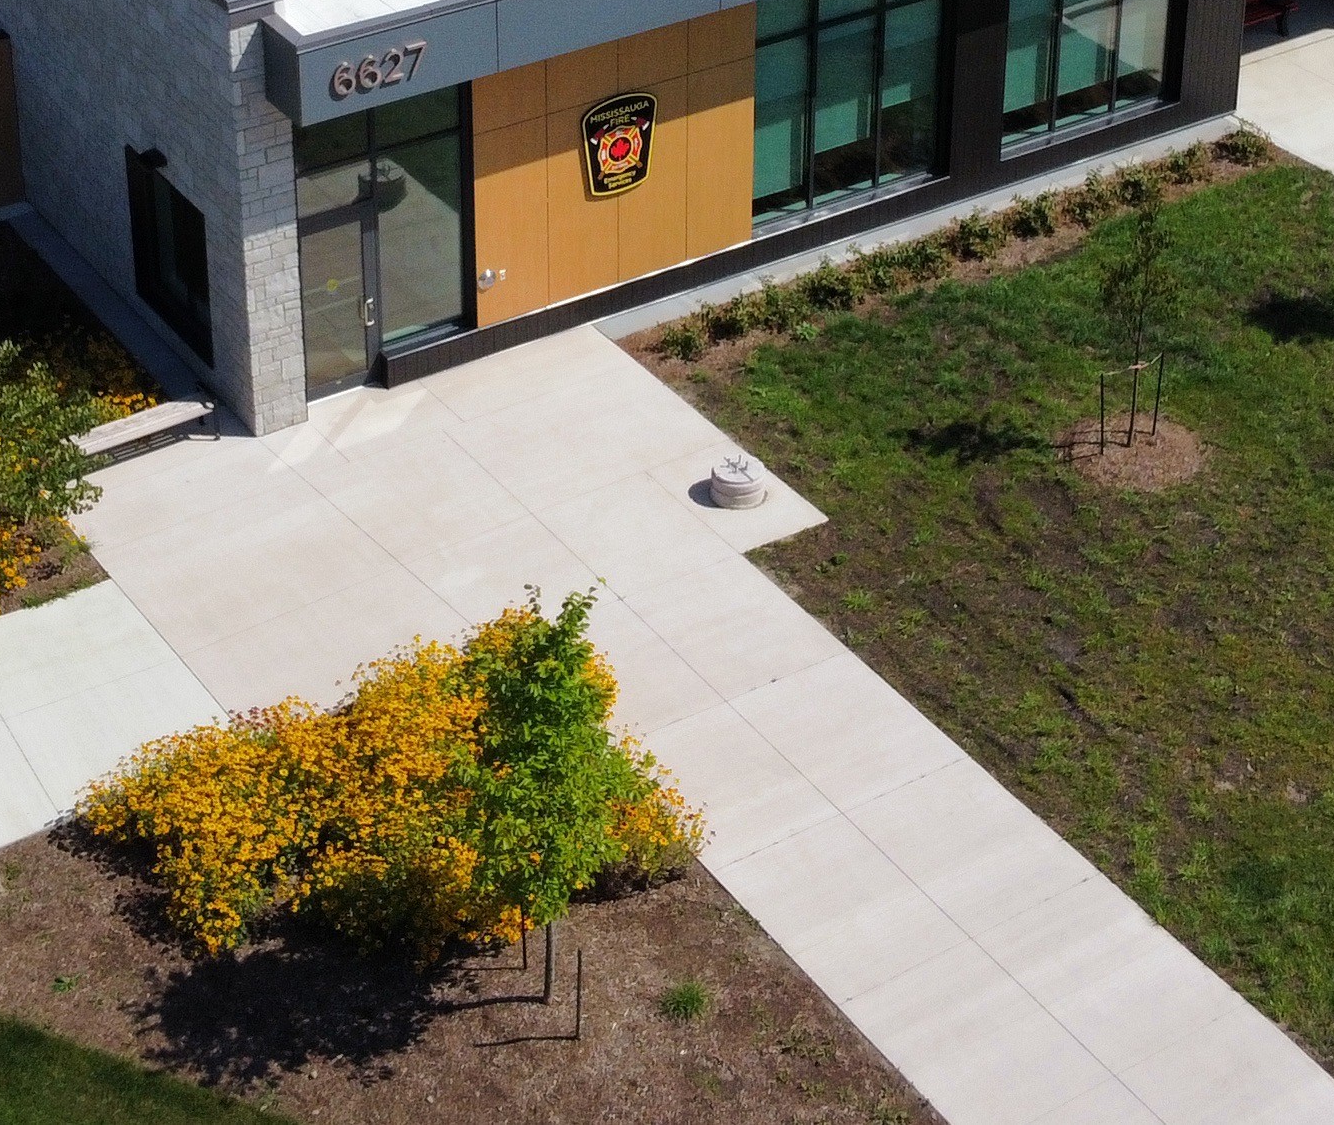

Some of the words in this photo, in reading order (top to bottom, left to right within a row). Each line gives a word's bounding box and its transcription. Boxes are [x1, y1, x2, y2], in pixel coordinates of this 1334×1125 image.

[331, 41, 427, 97] 6627
[590, 100, 649, 124] MISSISSAUGA
[610, 114, 630, 127] FIRE
